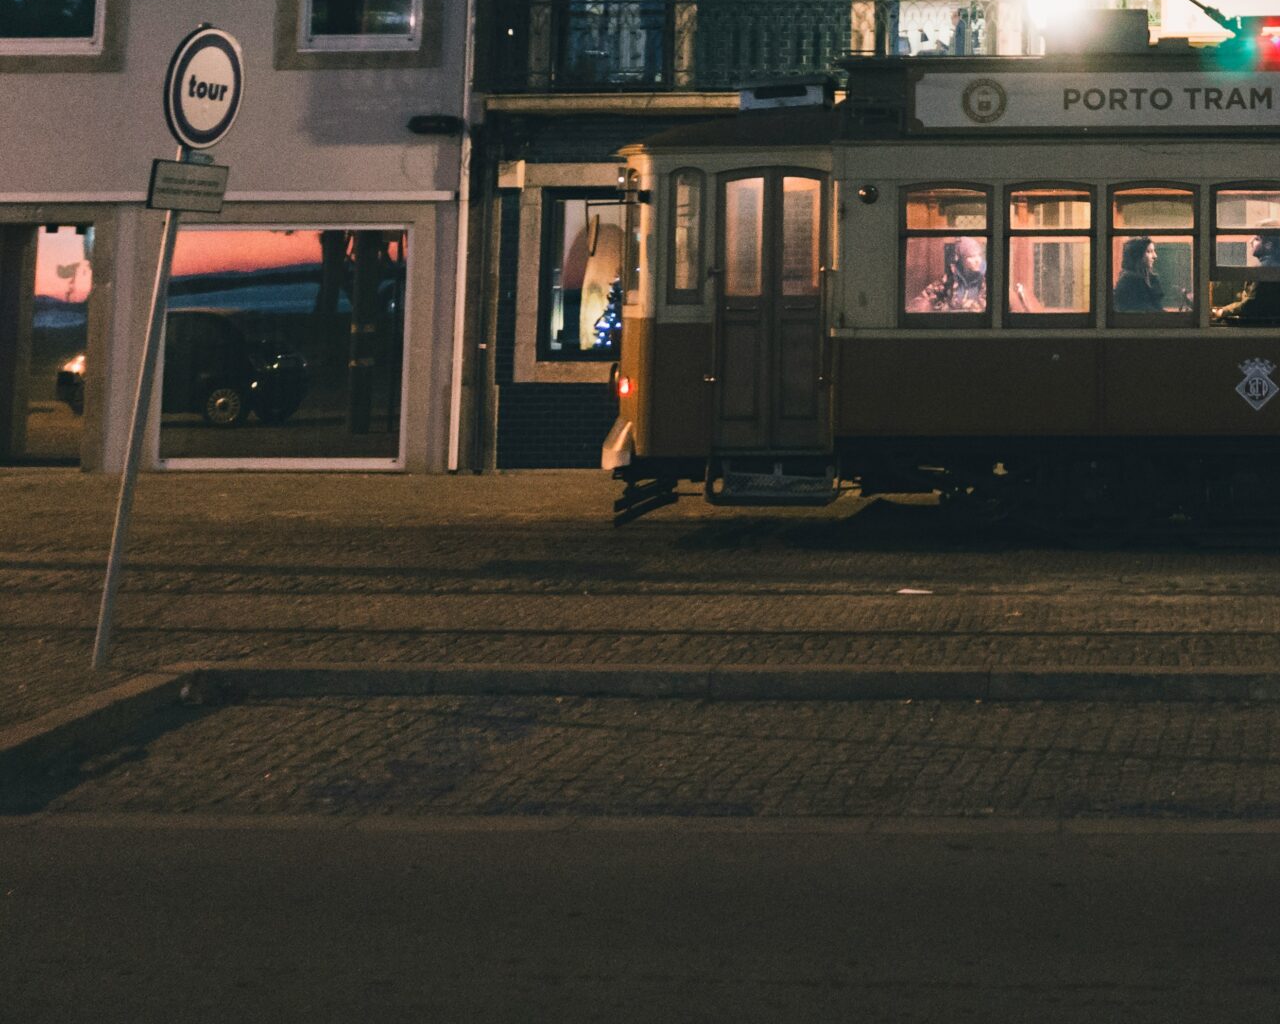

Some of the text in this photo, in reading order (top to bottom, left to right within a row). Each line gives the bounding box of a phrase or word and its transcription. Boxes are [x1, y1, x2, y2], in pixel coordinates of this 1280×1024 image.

[188, 75, 228, 101] tour
[1063, 87, 1173, 111] PORTO
[1184, 87, 1273, 110] TRAM
